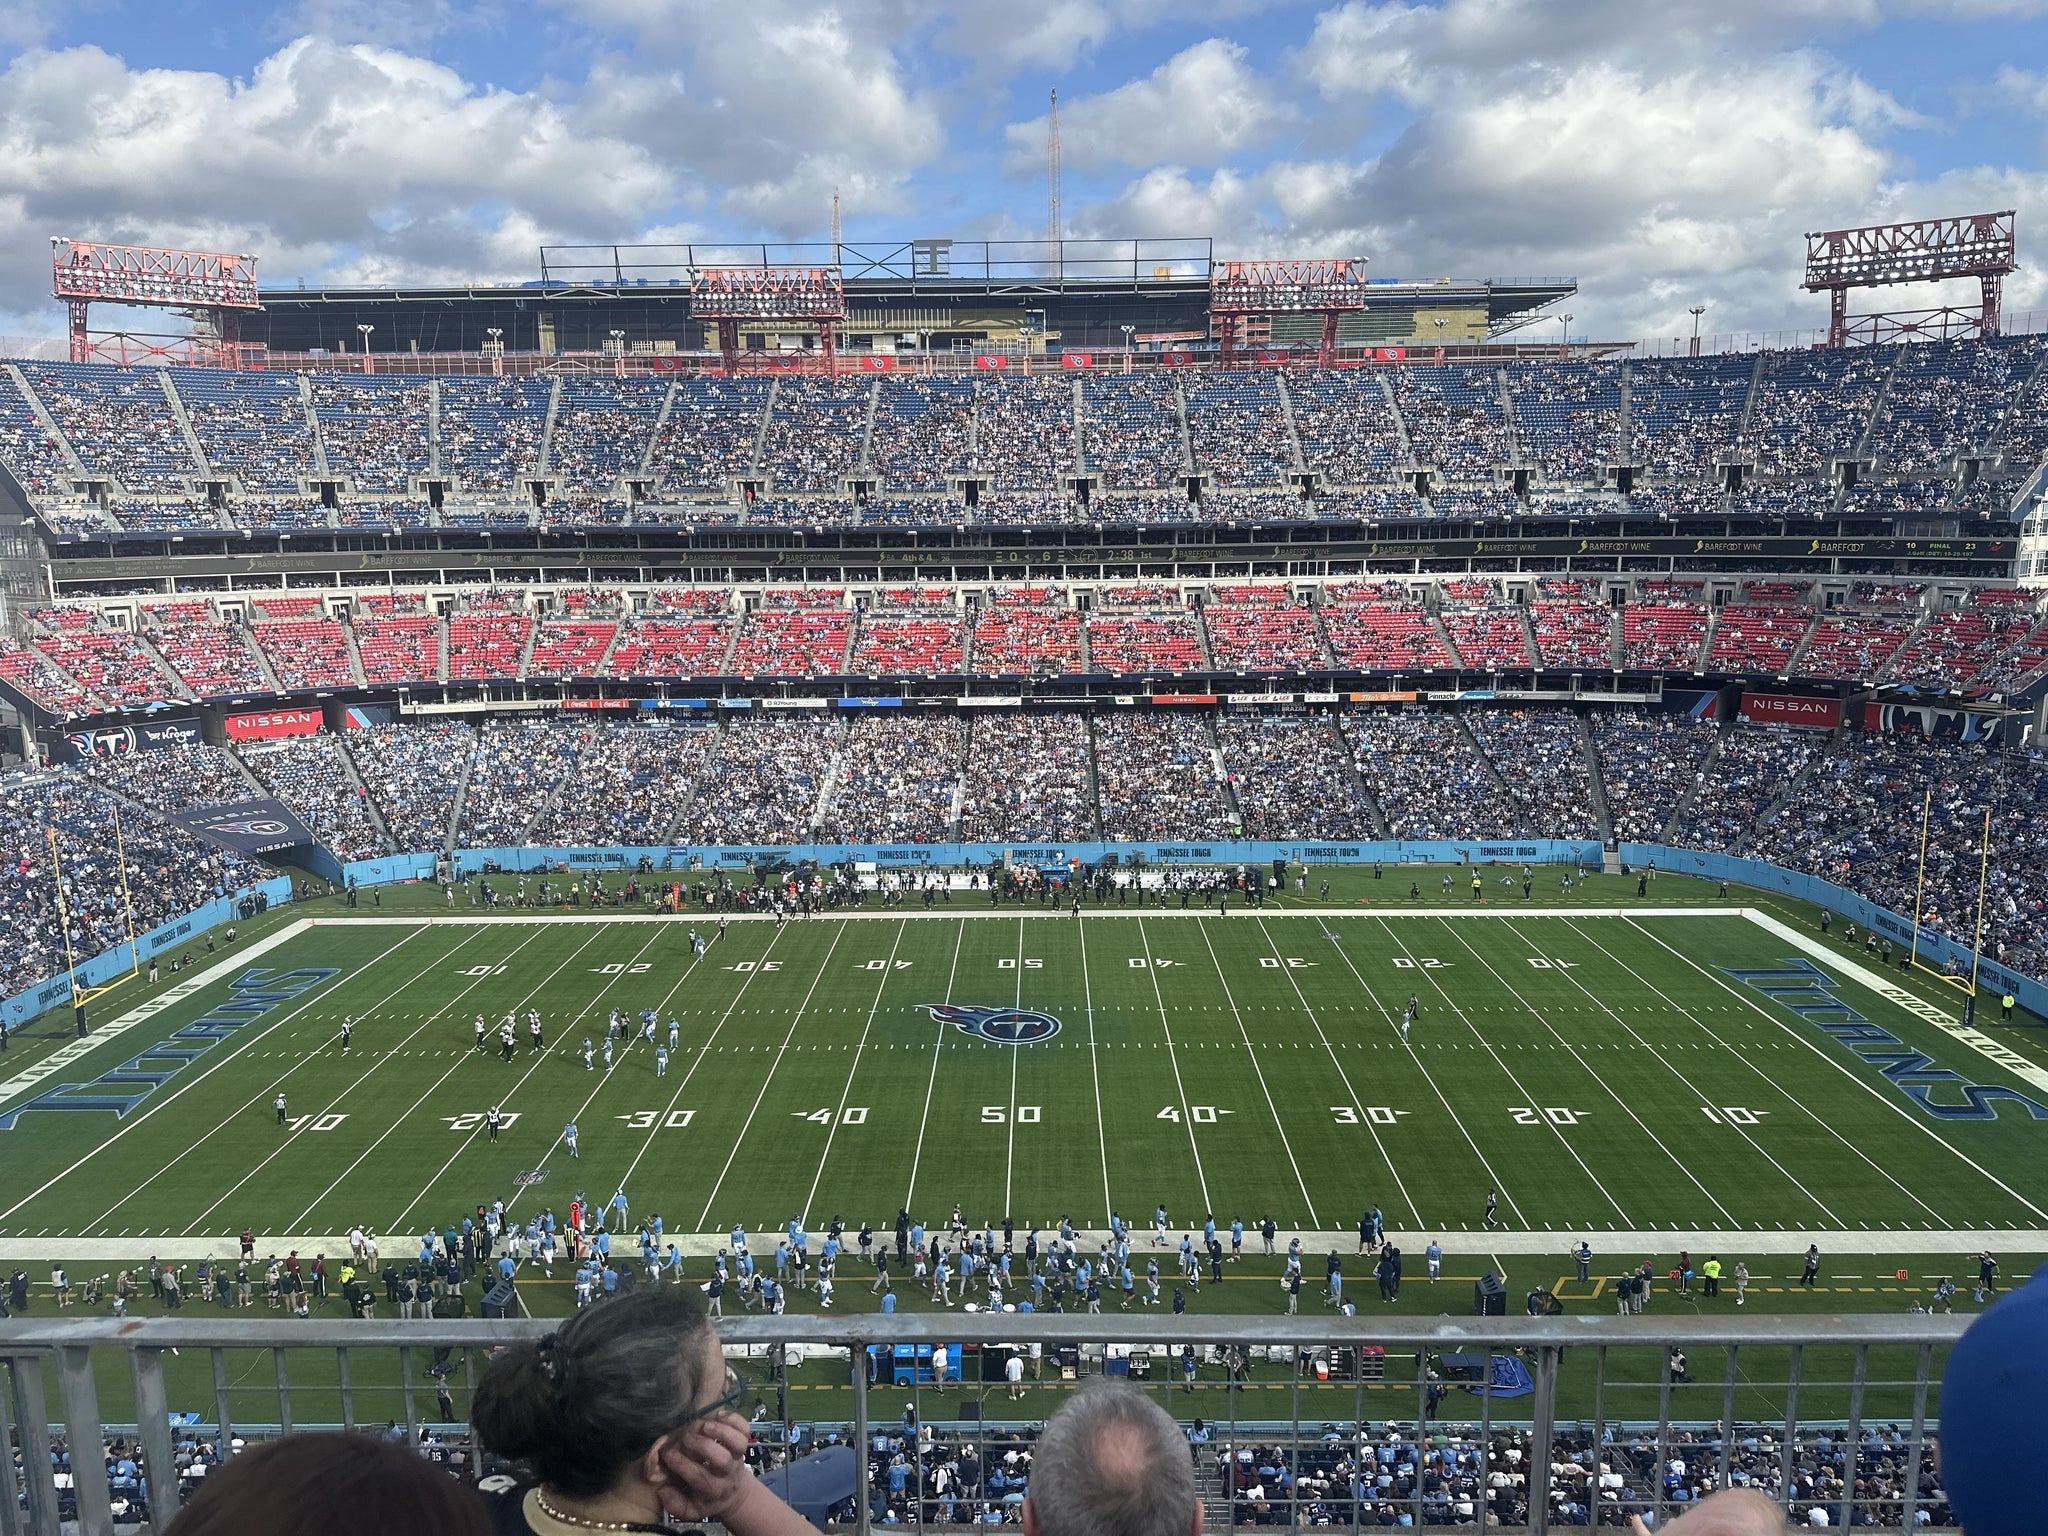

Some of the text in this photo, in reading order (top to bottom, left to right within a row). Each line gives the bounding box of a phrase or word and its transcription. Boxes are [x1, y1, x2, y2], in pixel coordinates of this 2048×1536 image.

[1280, 548, 1331, 556] BAREFOOT WINE
[1379, 545, 1435, 554] BAREFOOT WINE
[1484, 543, 1537, 552] BAREFOOT WINE
[1589, 542, 1650, 551] BAREFOOT WINE
[1704, 543, 1763, 551] BAREFOOT WINE
[1821, 543, 1865, 551] BAREFOOT
[484, 555, 514, 563] BAREFOOT
[586, 554, 643, 563] BAREFOOT WINE
[785, 554, 840, 562] BAREFOOT WINE
[902, 553, 917, 562] 4th
[918, 553, 925, 561] &
[926, 553, 932, 561] 4
[1010, 552, 1017, 561] 0
[1042, 551, 1051, 561] 6
[1107, 550, 1134, 560] 2:38
[1179, 549, 1234, 558] BAREFOOT WINE
[257, 559, 315, 568] BAREFOOT WINE
[371, 555, 433, 565] BAREFOOT WINE
[1428, 692, 1456, 700] Pinnacle
[1753, 699, 1828, 713] NISSAN
[237, 713, 311, 728] NISSAN
[162, 727, 196, 743] Kroger
[190, 809, 268, 825] NISSAN
[256, 841, 295, 853] NISSAN
[1157, 848, 1211, 857] TENNESSEE TOUGH
[1304, 847, 1360, 856] TENNESSEE TOUGH
[1480, 846, 1537, 856] TENNESSEE TOUGH
[569, 853, 625, 863] TENNESSEE TOUGH
[877, 851, 910, 859] TENNESSEE
[1875, 913, 1899, 934] TENNESSEE
[151, 921, 192, 950] TENNESSEE TOUGH
[733, 961, 784, 972] 30
[865, 959, 913, 970] 40
[997, 958, 1044, 969] 50
[1128, 958, 1174, 969] 40
[1259, 957, 1308, 968] 30
[1391, 957, 1445, 968] 20
[1526, 957, 1570, 969] 10
[464, 964, 509, 976] 10
[599, 963, 653, 974] 20
[1977, 962, 2020, 995] NNESSEE TOUGH
[38, 981, 69, 1005] TENNESSEE
[1880, 988, 2035, 1070] CHOOSE LOVE
[8, 1042, 96, 1085] TAKES
[92, 1017, 142, 1037] ALL
[140, 1000, 169, 1018] OF
[1710, 957, 2048, 1121] TITANS
[0, 968, 342, 1131] TITANS
[625, 1110, 697, 1128] 30
[806, 1106, 871, 1125] 40
[980, 1105, 1042, 1124] 50
[1155, 1105, 1218, 1123] 40
[1329, 1106, 1398, 1124] 30
[1506, 1106, 1580, 1125] 20
[1700, 1106, 1761, 1124] 10
[288, 1113, 350, 1131] 10
[449, 1112, 524, 1130] 20
[518, 1176, 543, 1184] NFL
[1670, 1270, 1680, 1279] 20
[1898, 1270, 1907, 1279] 10
